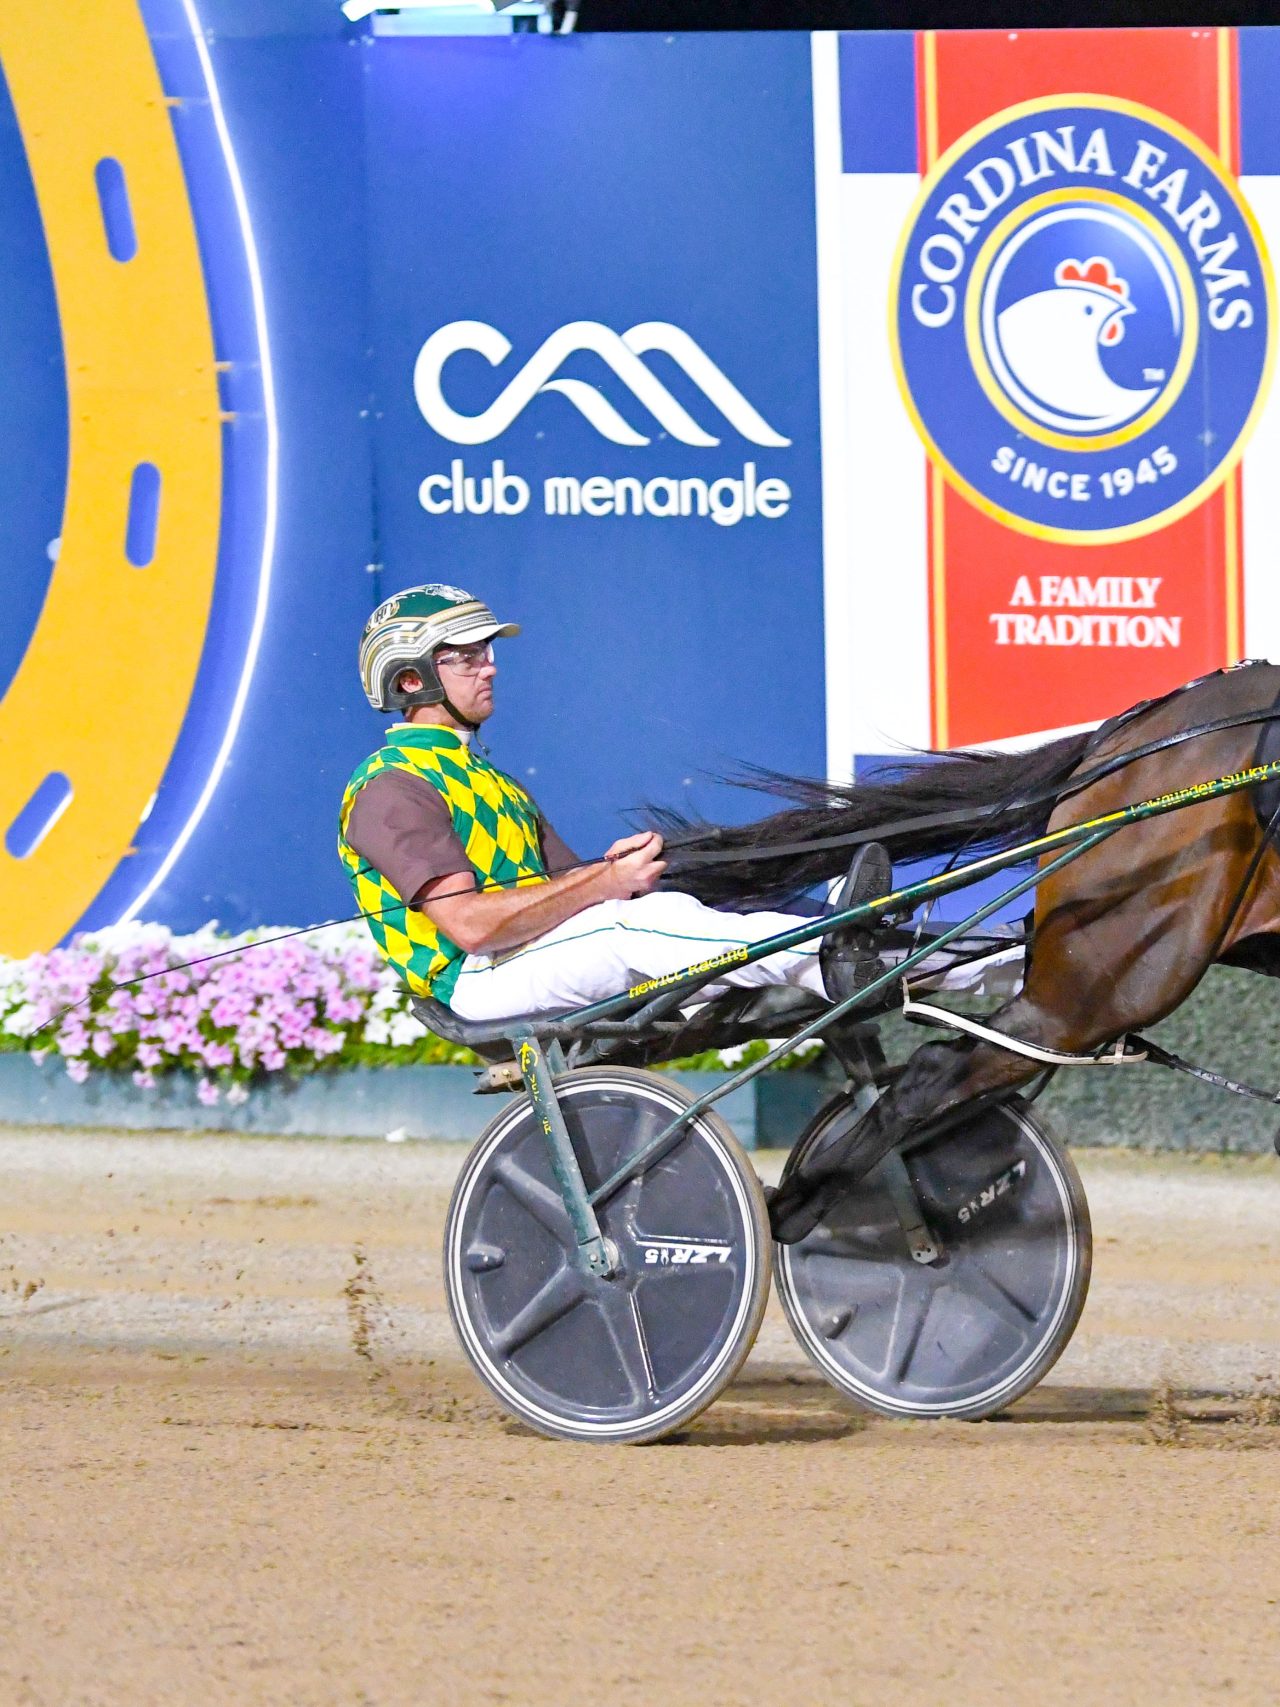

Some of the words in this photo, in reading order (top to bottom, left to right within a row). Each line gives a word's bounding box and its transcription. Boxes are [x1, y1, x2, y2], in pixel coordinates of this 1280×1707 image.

[912, 124, 1117, 328] CORDINA
[1121, 139, 1253, 332] FARMS
[418, 458, 531, 514] club
[544, 461, 792, 526] menangle
[990, 446, 1092, 502] SINCE
[1098, 445, 1178, 499] 1945
[1009, 575, 1036, 607] A
[1039, 575, 1163, 609] FAMILY
[989, 613, 1183, 648] TRADITION
